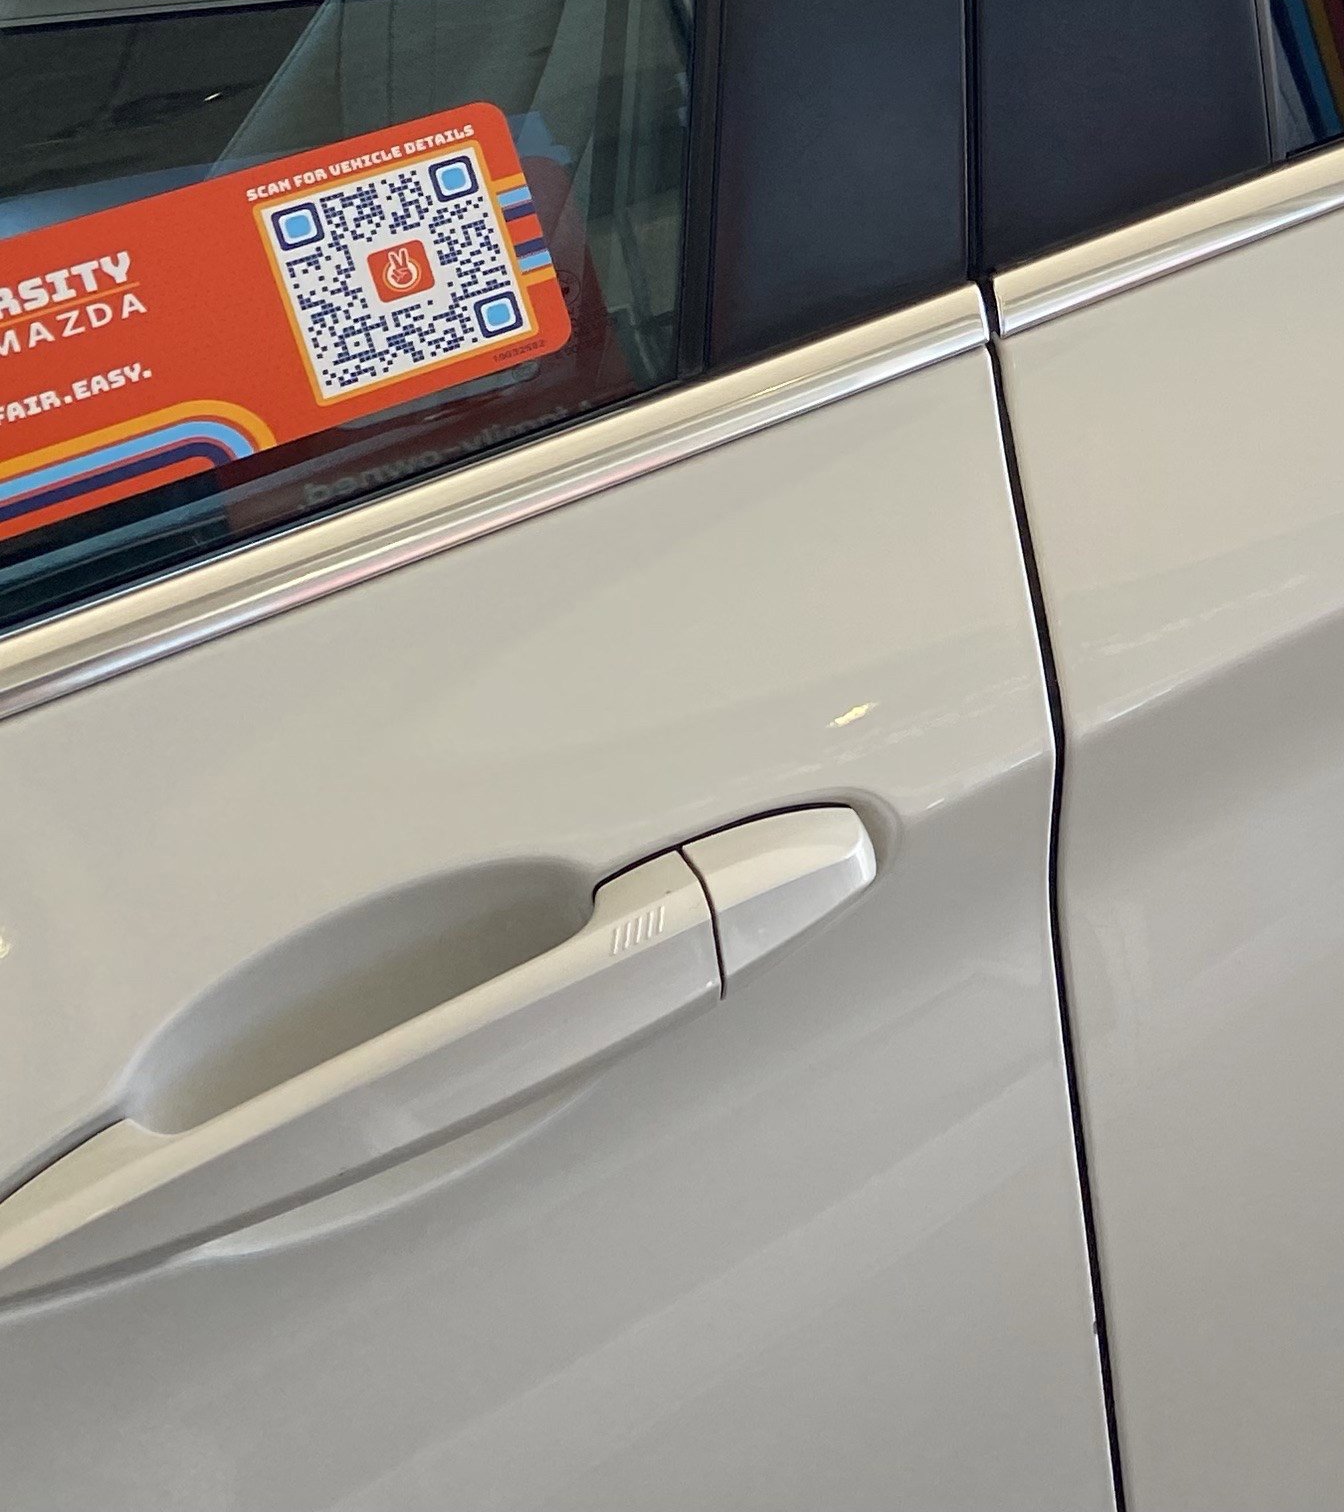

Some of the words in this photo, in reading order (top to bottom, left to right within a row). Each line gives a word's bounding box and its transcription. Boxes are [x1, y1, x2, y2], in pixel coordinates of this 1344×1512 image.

[246, 178, 292, 202] SCAN
[293, 164, 328, 188] FOR
[328, 145, 402, 177] VEHICLE
[403, 124, 475, 155] DETAILS
[0, 293, 148, 357] MAZDA
[0, 362, 153, 426] AIR.EASY.
